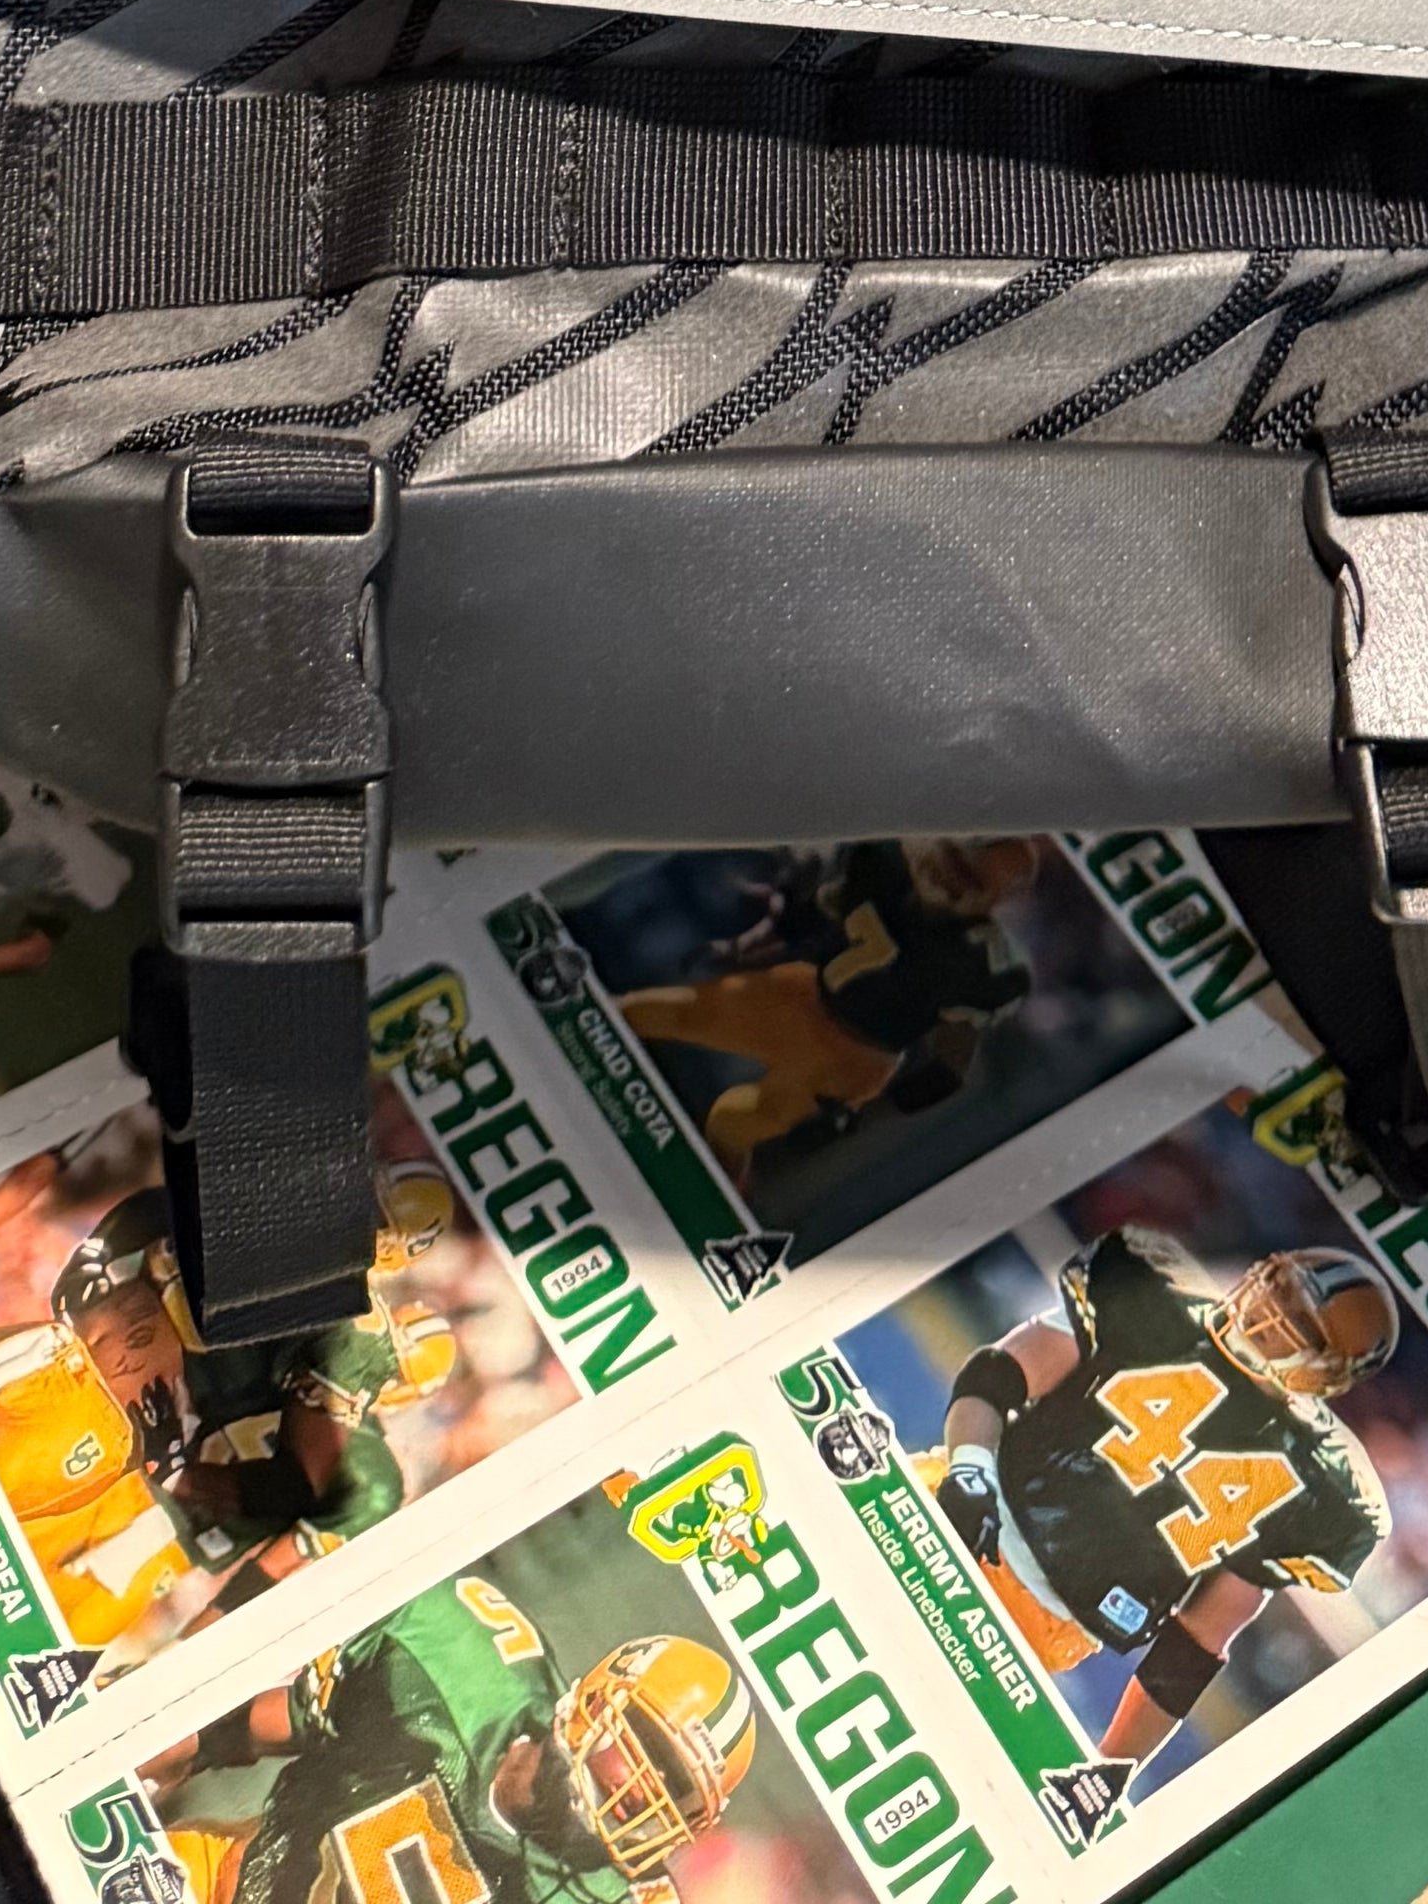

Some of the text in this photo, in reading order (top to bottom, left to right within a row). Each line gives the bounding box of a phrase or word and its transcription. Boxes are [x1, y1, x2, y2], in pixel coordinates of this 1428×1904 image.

[577, 1007, 676, 1152] CHAD COTA
[549, 1252, 605, 1295] 1994
[1091, 1361, 1307, 1577] 44
[858, 1499, 983, 1685] Inside Linebacker
[880, 1485, 1039, 1715] JEREMY ASHER
[873, 1788, 931, 1837] 1994
